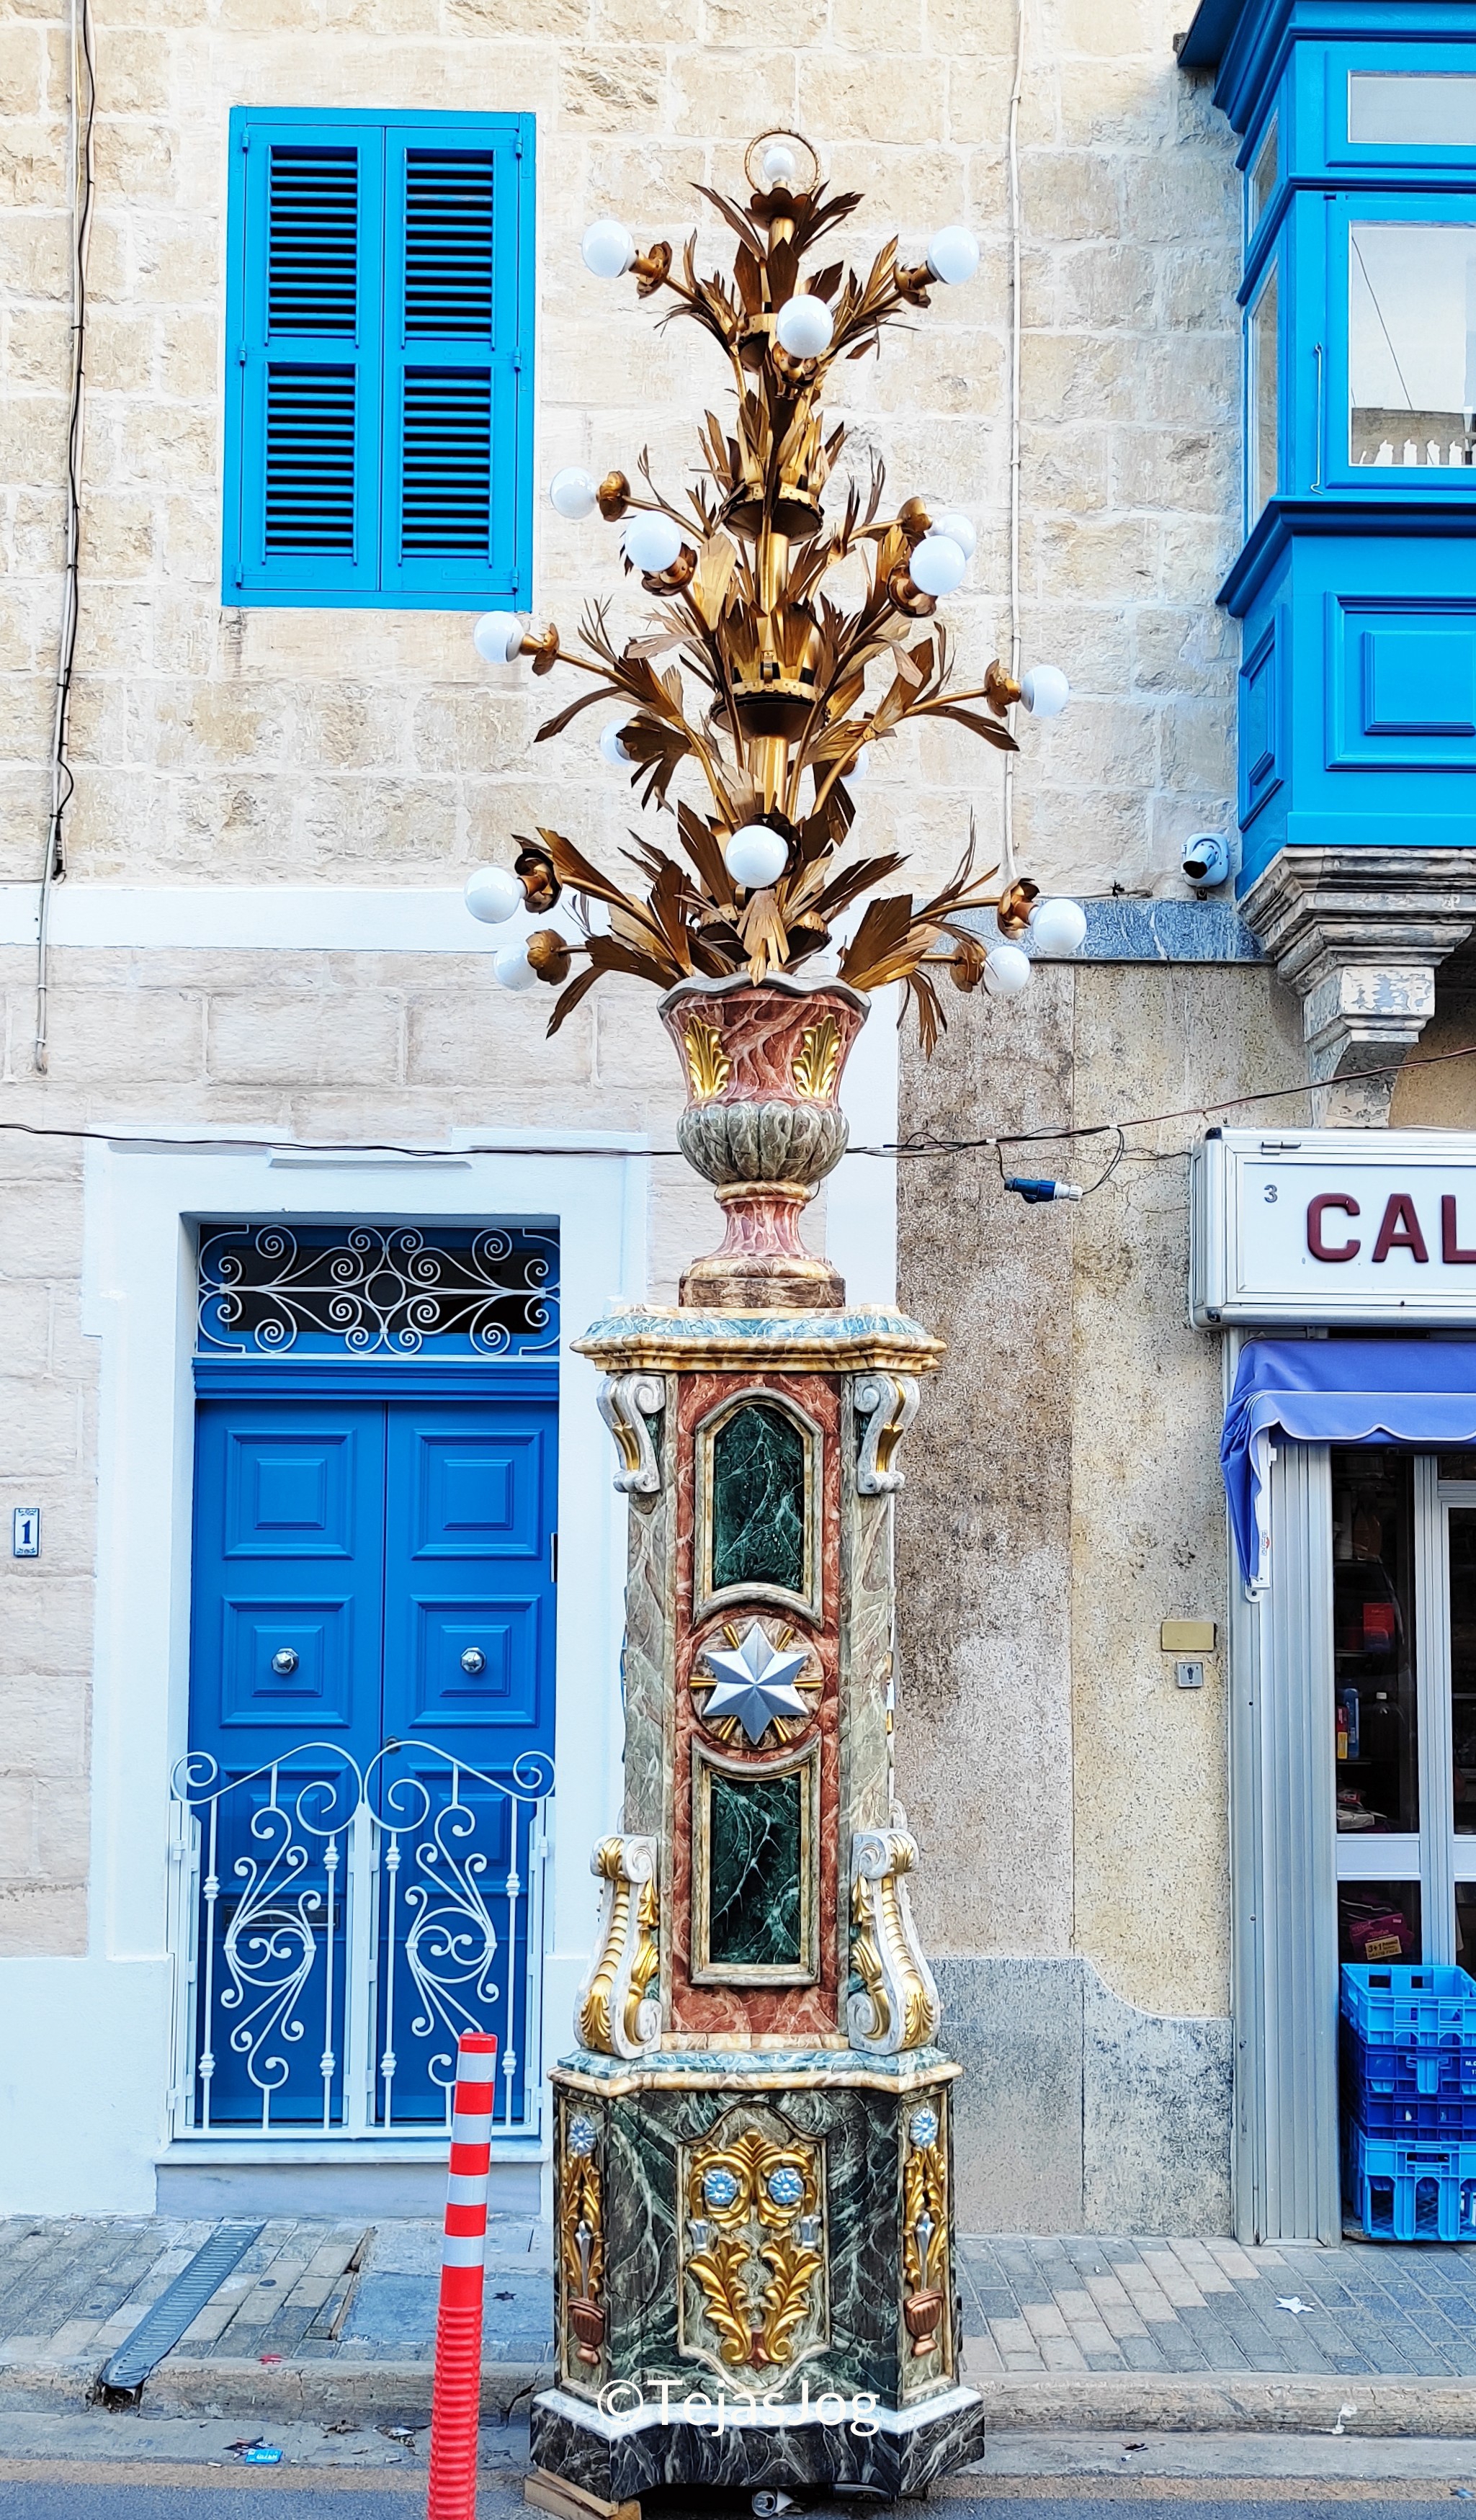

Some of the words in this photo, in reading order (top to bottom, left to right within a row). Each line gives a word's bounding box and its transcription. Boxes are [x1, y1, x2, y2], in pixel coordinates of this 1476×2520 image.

[1263, 1184, 1278, 1203] 3
[1306, 1193, 1476, 1264] CAL
[22, 1520, 31, 1544] 1
